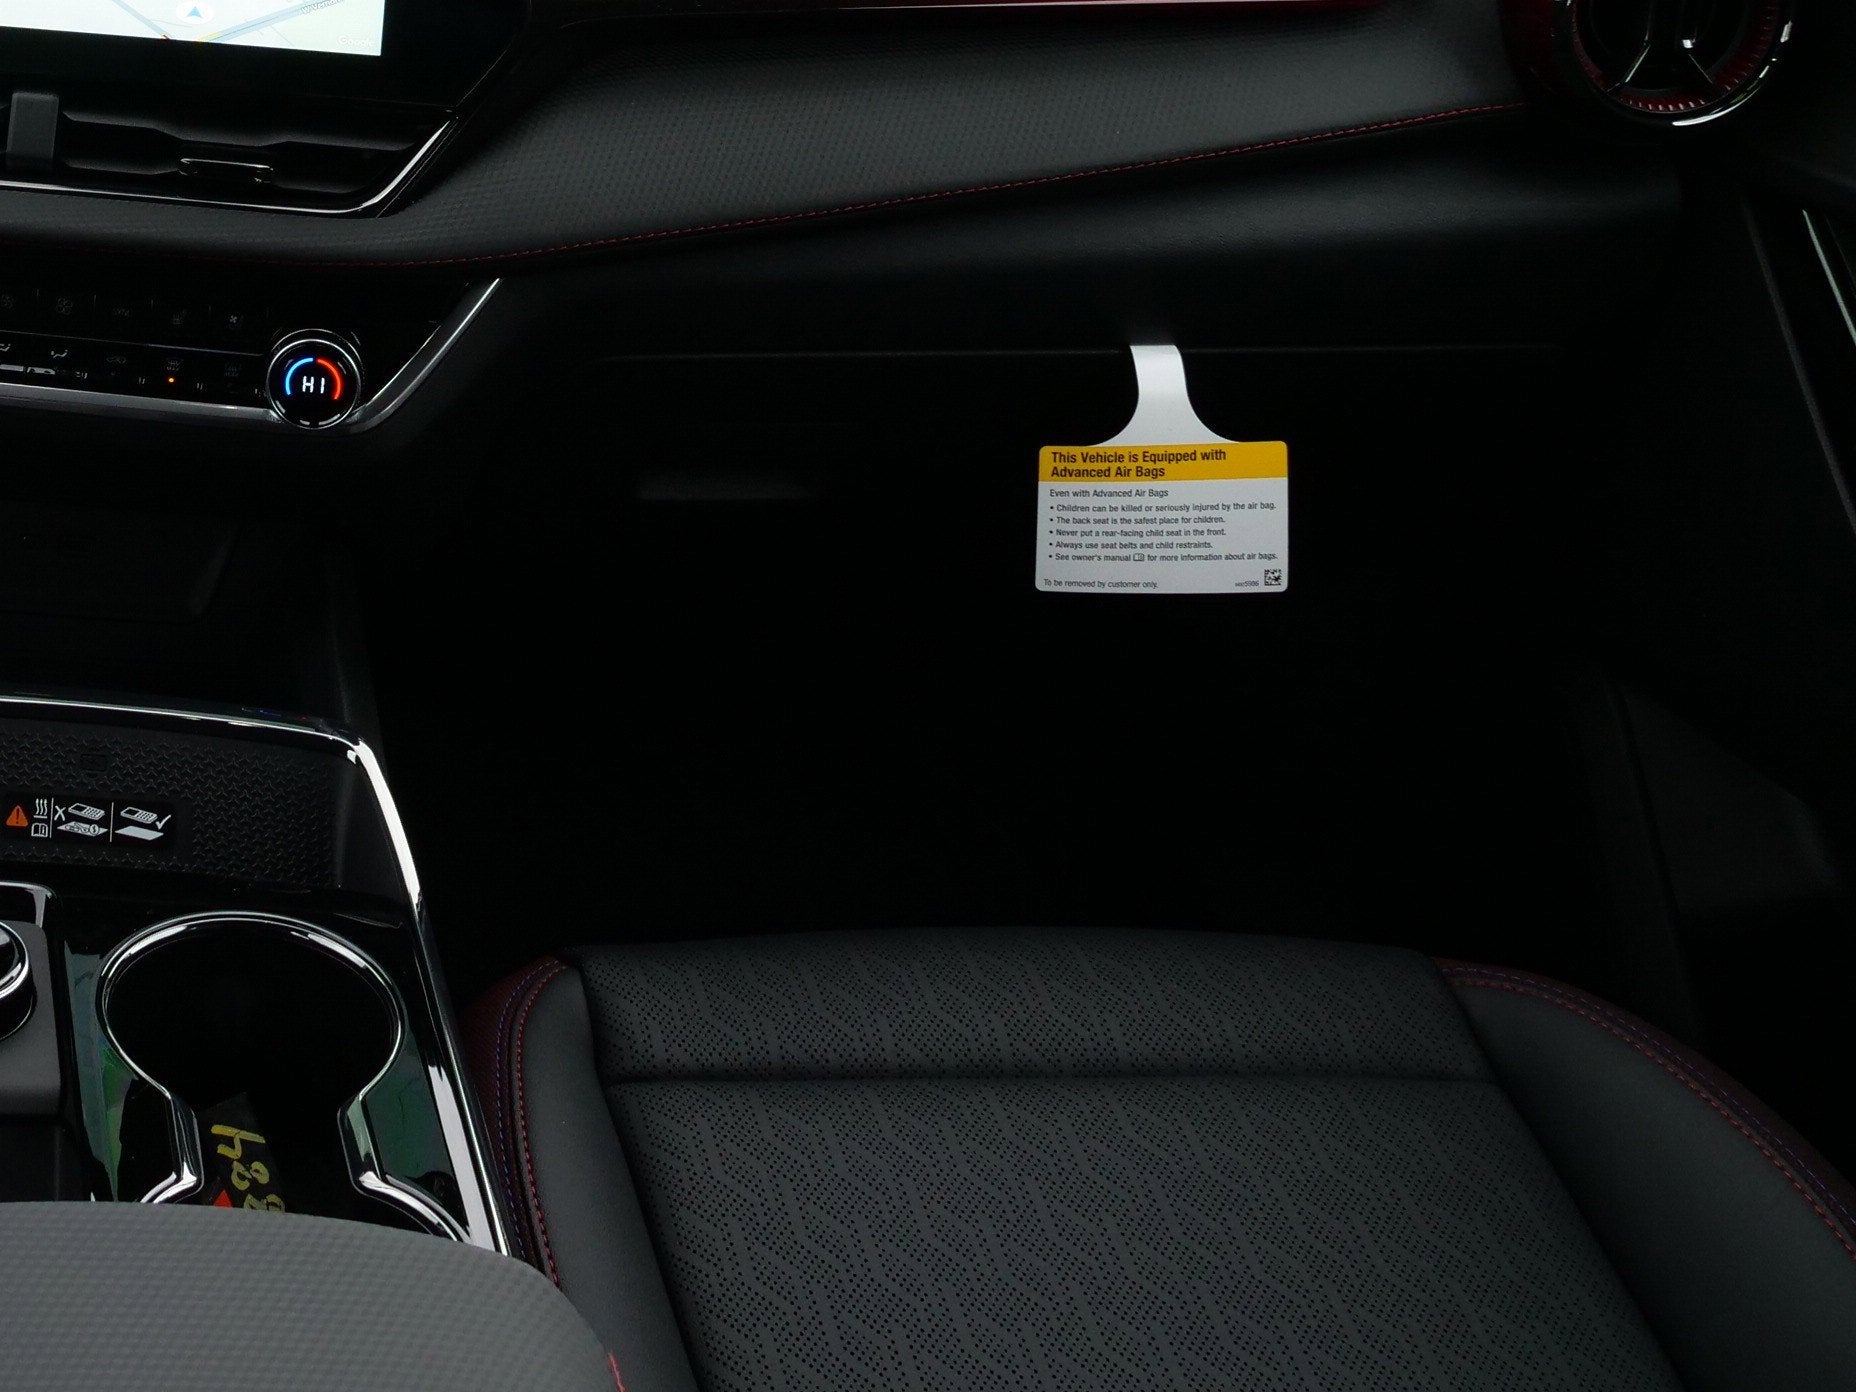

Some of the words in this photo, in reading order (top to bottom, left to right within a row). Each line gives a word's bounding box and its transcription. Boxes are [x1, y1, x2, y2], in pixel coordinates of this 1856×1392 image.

[301, 375, 326, 393] HI
[1051, 452, 1077, 463] This
[1080, 451, 1125, 463] Vehicle
[1128, 451, 1139, 462] is
[1142, 450, 1197, 463] Equipped
[1200, 449, 1227, 461] with
[1050, 466, 1111, 478] Advanced
[1115, 466, 1134, 477] Air
[1136, 466, 1165, 479] Bags
[1049, 489, 1070, 498] Even
[1071, 489, 1090, 498] with
[1092, 489, 1133, 498] Advanced
[1134, 489, 1146, 498] Air
[1148, 489, 1169, 499] Bags
[1056, 503, 1090, 512] Children
[1091, 503, 1107, 512] can
[1108, 503, 1119, 511] be
[1120, 503, 1143, 511] killed
[1144, 503, 1153, 511] or
[1155, 502, 1190, 512] seriously
[1192, 502, 1220, 512] injured
[1221, 502, 1231, 512] by
[1233, 502, 1246, 510] the
[1247, 502, 1258, 510] air
[1259, 502, 1276, 512] bag.
[1056, 516, 1071, 524] The
[1072, 516, 1091, 524] back
[1093, 516, 1109, 524] seat
[1111, 516, 1118, 524] is
[1119, 516, 1132, 524] the
[1133, 516, 1157, 524] safest
[1158, 516, 1179, 526] place
[1181, 516, 1192, 524] for
[1193, 516, 1226, 524] children.
[1056, 528, 1079, 536] Never
[1080, 528, 1093, 538] put
[1094, 528, 1100, 536] a
[1101, 528, 1144, 538] rear-facing
[1145, 528, 1164, 536] child
[1165, 528, 1182, 536] seat
[1183, 528, 1190, 536] in
[1192, 528, 1205, 536] the
[1206, 528, 1227, 536] front.
[1055, 541, 1083, 550] Always
[1155, 540, 1174, 548] child
[1176, 540, 1213, 548] restraints.
[1055, 553, 1070, 561] See
[1071, 553, 1102, 561] owner's
[1103, 553, 1131, 561] manual
[1147, 552, 1157, 560] for
[1159, 552, 1179, 560] more
[1180, 552, 1222, 560] information
[1224, 552, 1245, 560] about
[1246, 552, 1257, 560] air
[1258, 552, 1279, 561] bags.
[1043, 579, 1053, 587] To
[1055, 579, 1063, 587] be
[1064, 579, 1096, 587] removed
[1097, 579, 1106, 589] by
[1107, 579, 1140, 587] customer
[1142, 579, 1158, 589] only.
